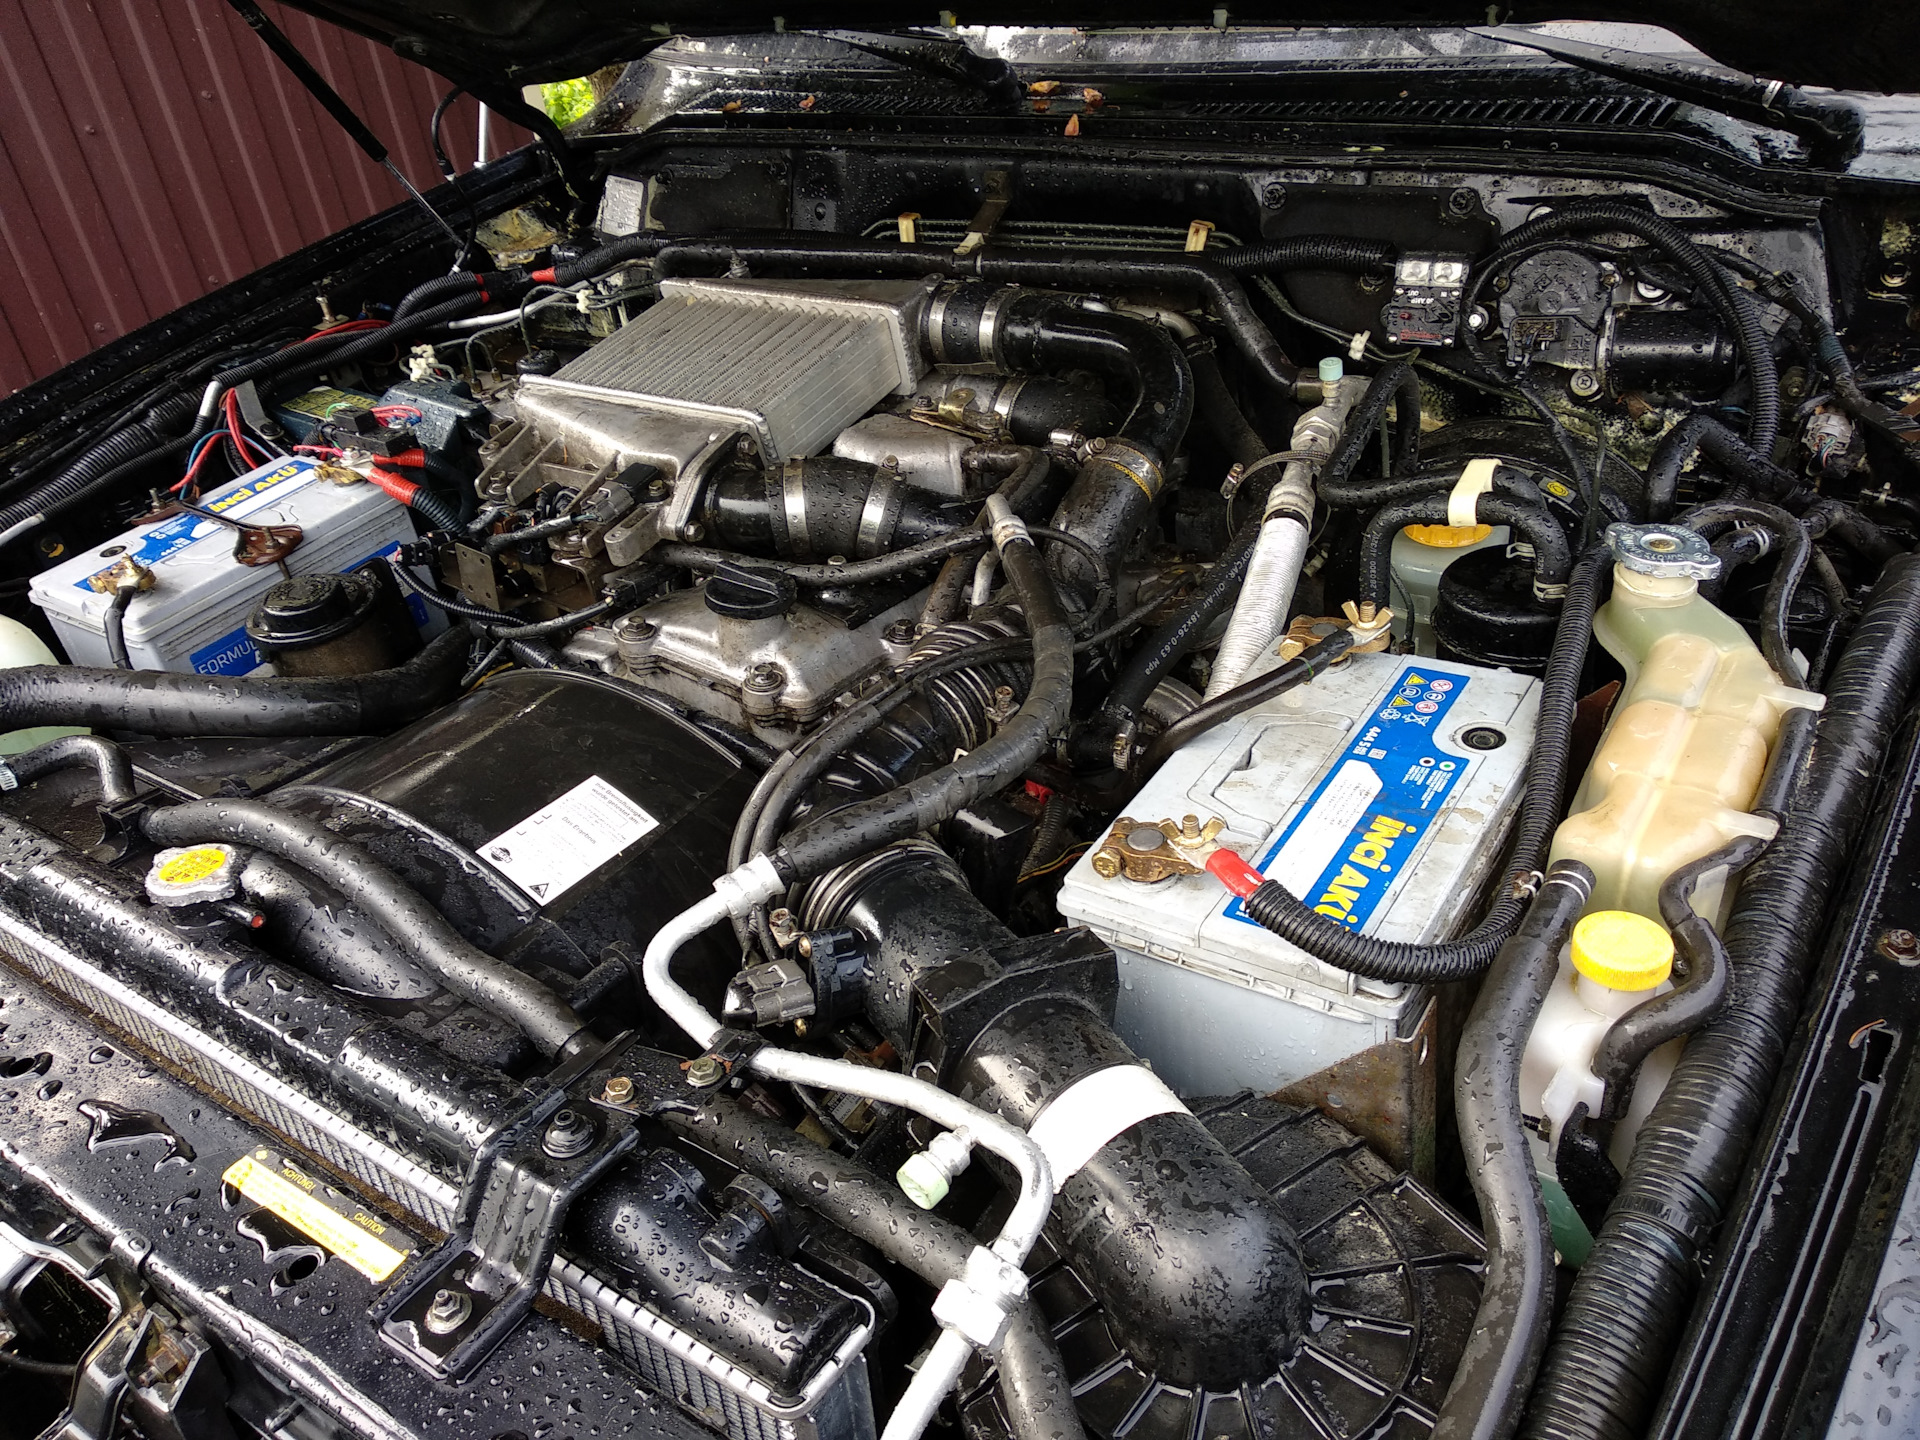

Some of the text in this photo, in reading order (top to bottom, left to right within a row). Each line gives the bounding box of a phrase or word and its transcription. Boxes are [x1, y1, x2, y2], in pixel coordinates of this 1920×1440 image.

[198, 640, 258, 674] FORMUL
[1144, 658, 1161, 676] Mpa
[561, 816, 574, 828] Das
[281, 1167, 317, 1191] ACHTUNG!
[353, 1211, 387, 1236] CAUTION
